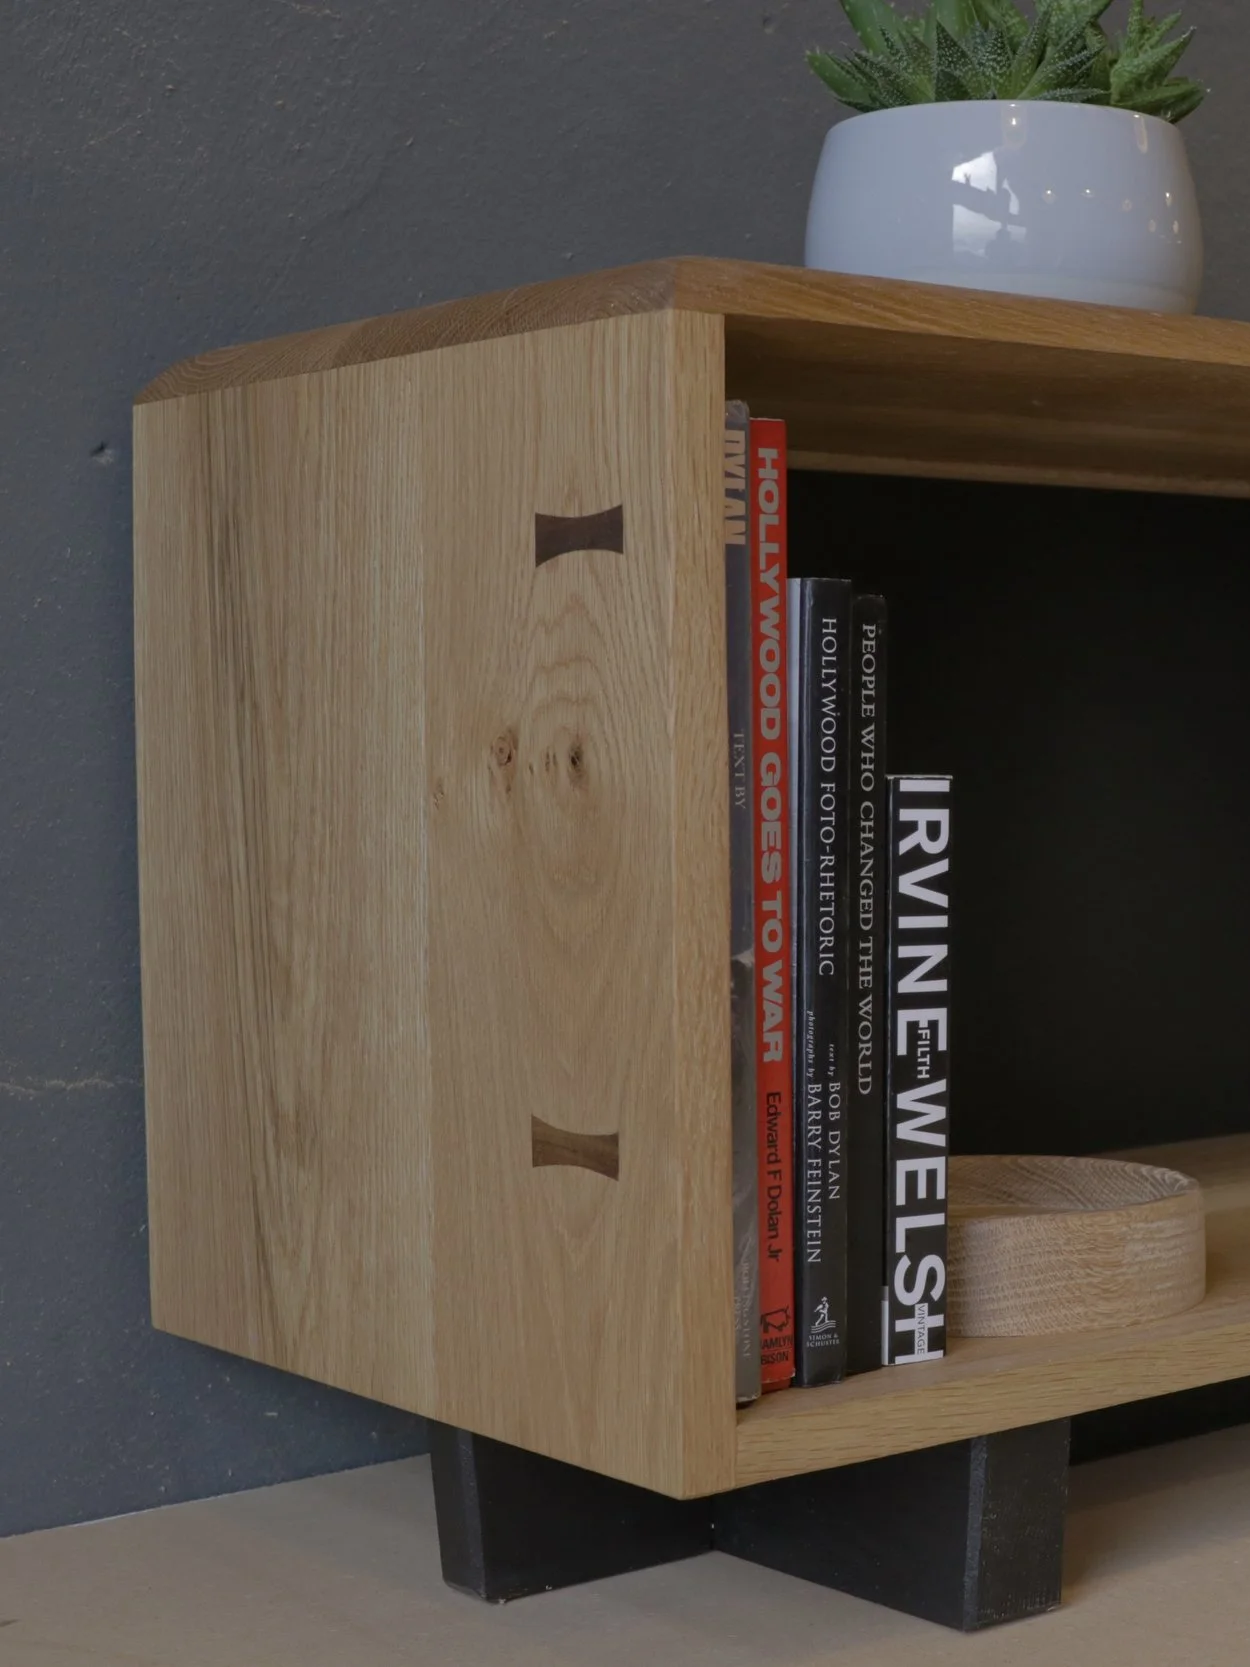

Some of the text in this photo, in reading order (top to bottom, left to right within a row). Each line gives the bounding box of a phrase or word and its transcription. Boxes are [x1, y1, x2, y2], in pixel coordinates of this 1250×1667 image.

[733, 731, 747, 809] TEXT BY
[758, 447, 784, 1063] HOLLYWOOD GOES TO WAR
[819, 618, 837, 976] HOLLYWOOD FOTO-RHETORIC
[858, 624, 876, 1095] PEOPLE WHO CHANGED THE WORLD
[828, 1066, 835, 1077] by
[894, 779, 950, 1365] IRVINE WELSH
[917, 1027, 930, 1079] FILTH
[806, 1010, 821, 1263] photographs by BARRY FEINSTEIN
[828, 1082, 841, 1122] BOB
[766, 1091, 783, 1263] Edward F Dolan Jr
[828, 1131, 841, 1200] DYLAN
[761, 1335, 793, 1350] AMLYN
[806, 1339, 840, 1348] SCHUSTER
[809, 1333, 832, 1341] SIMON
[915, 1306, 928, 1355] VINTAGE
